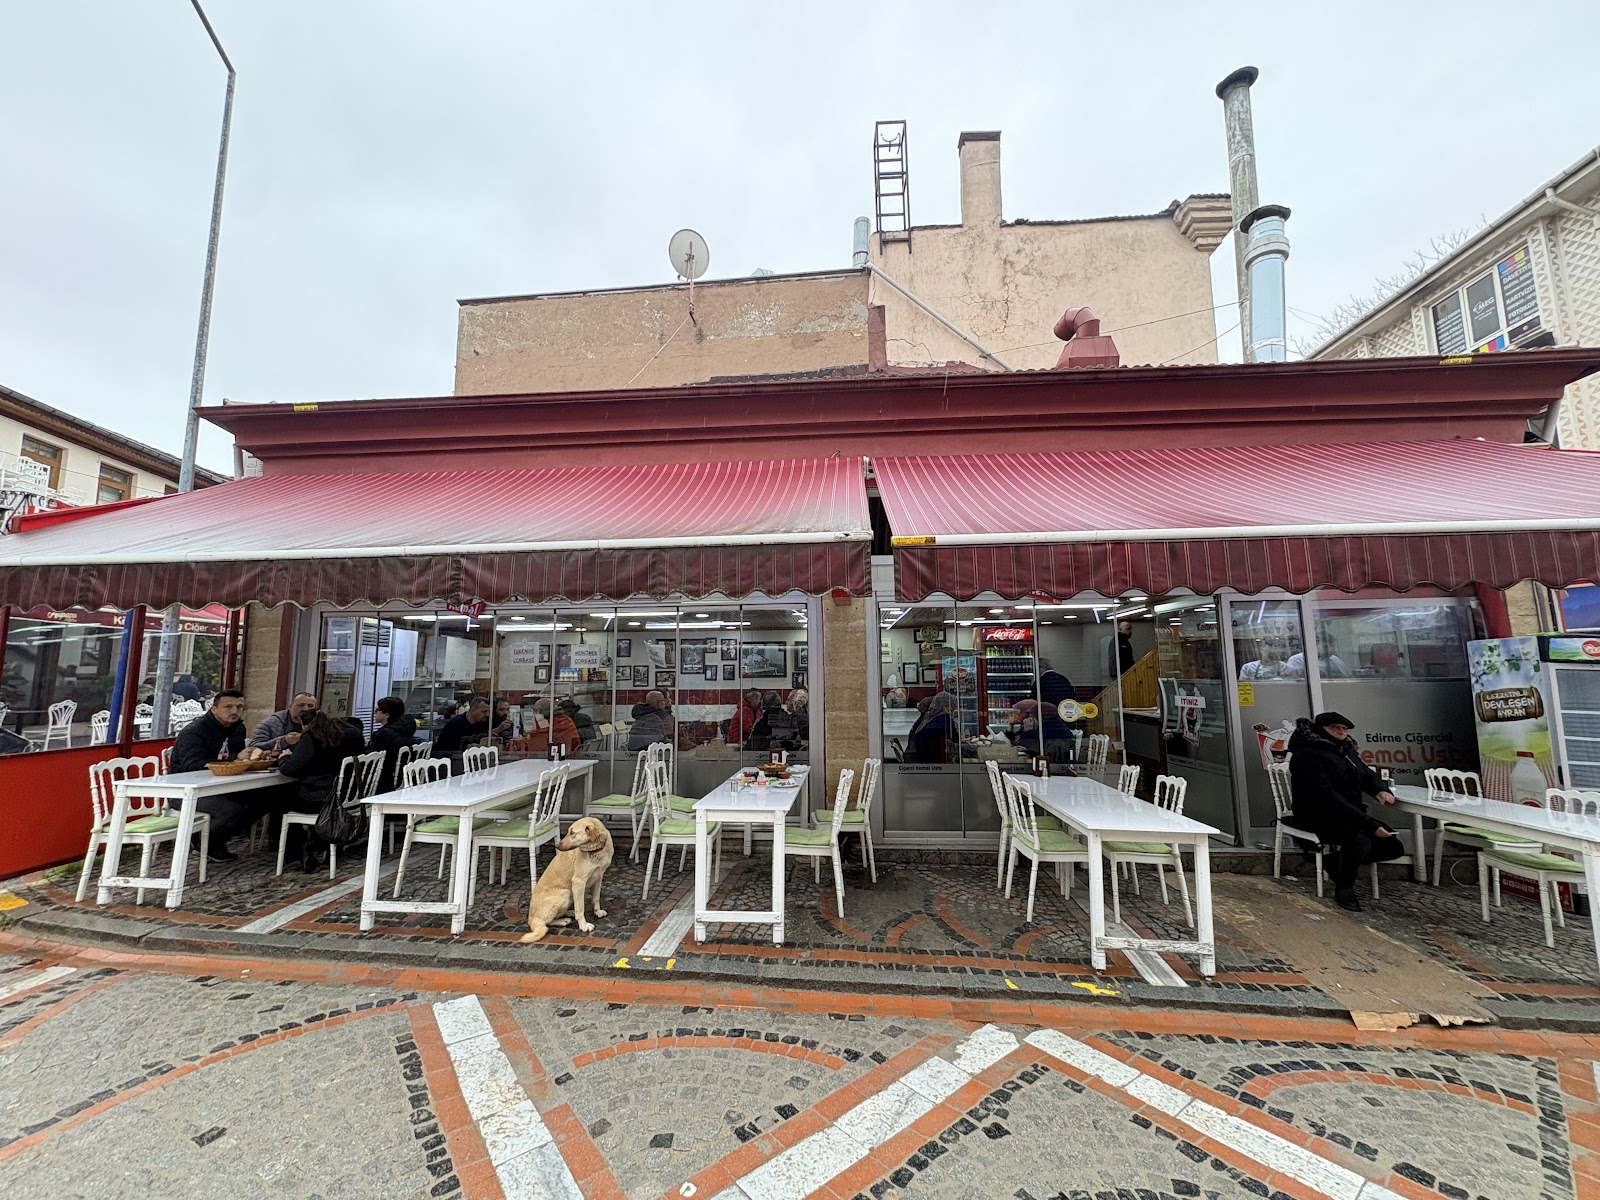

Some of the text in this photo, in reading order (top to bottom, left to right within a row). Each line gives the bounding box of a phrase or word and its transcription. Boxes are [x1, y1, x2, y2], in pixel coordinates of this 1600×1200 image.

[1477, 296, 1495, 310] MEG
[1508, 299, 1537, 319] FOTOKOP
[184, 621, 209, 632] Ciğer
[1484, 696, 1535, 710] DEVLEŞEN
[1497, 708, 1526, 718] AYRAN
[1366, 732, 1453, 745] Edirne Ciğercisi
[1360, 745, 1416, 764] emal
